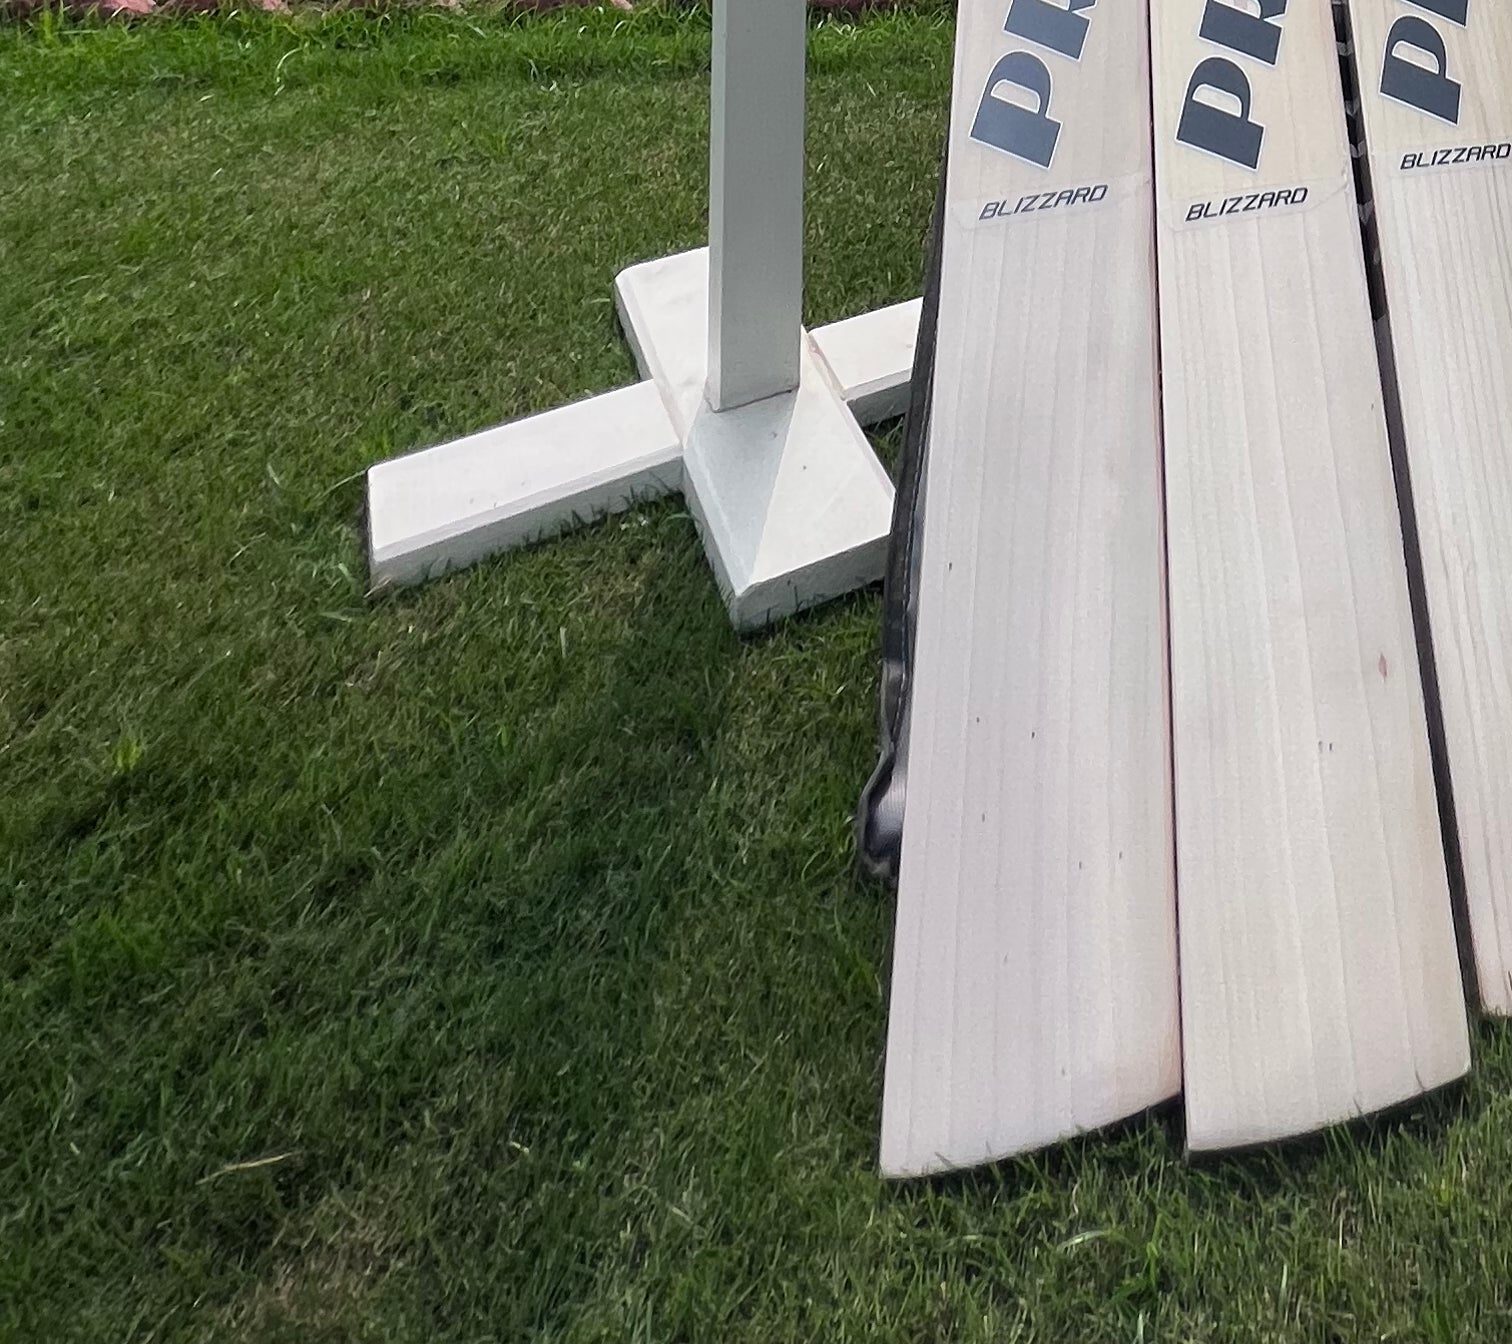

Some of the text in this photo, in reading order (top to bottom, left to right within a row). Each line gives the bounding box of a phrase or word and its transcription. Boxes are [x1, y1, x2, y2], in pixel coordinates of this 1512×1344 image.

[1399, 143, 1512, 171] BLIZZARD
[979, 184, 1109, 221] BLIZZARD
[1184, 186, 1309, 222] BLIZZARD
